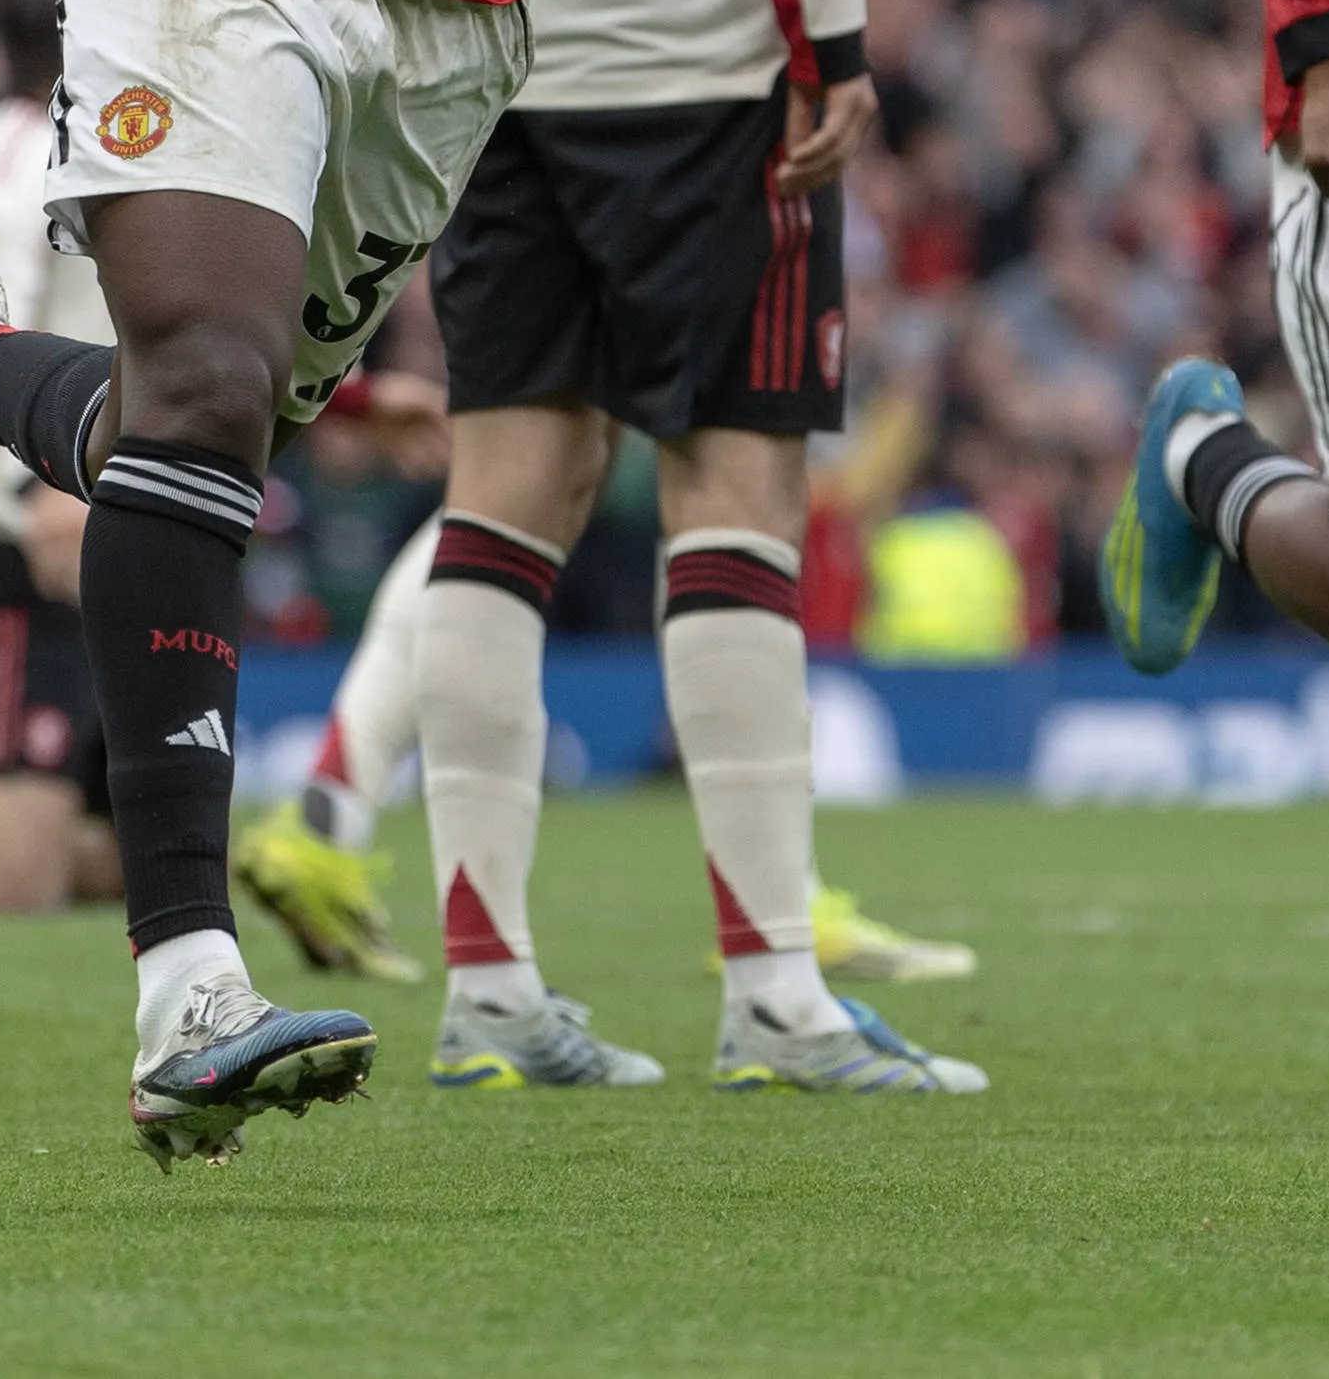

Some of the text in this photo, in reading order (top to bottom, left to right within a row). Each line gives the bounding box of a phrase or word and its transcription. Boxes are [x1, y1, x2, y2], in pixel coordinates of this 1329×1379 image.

[105, 92, 166, 119] MANCHESTER
[112, 139, 155, 155] UNITED
[302, 230, 433, 344] 3
